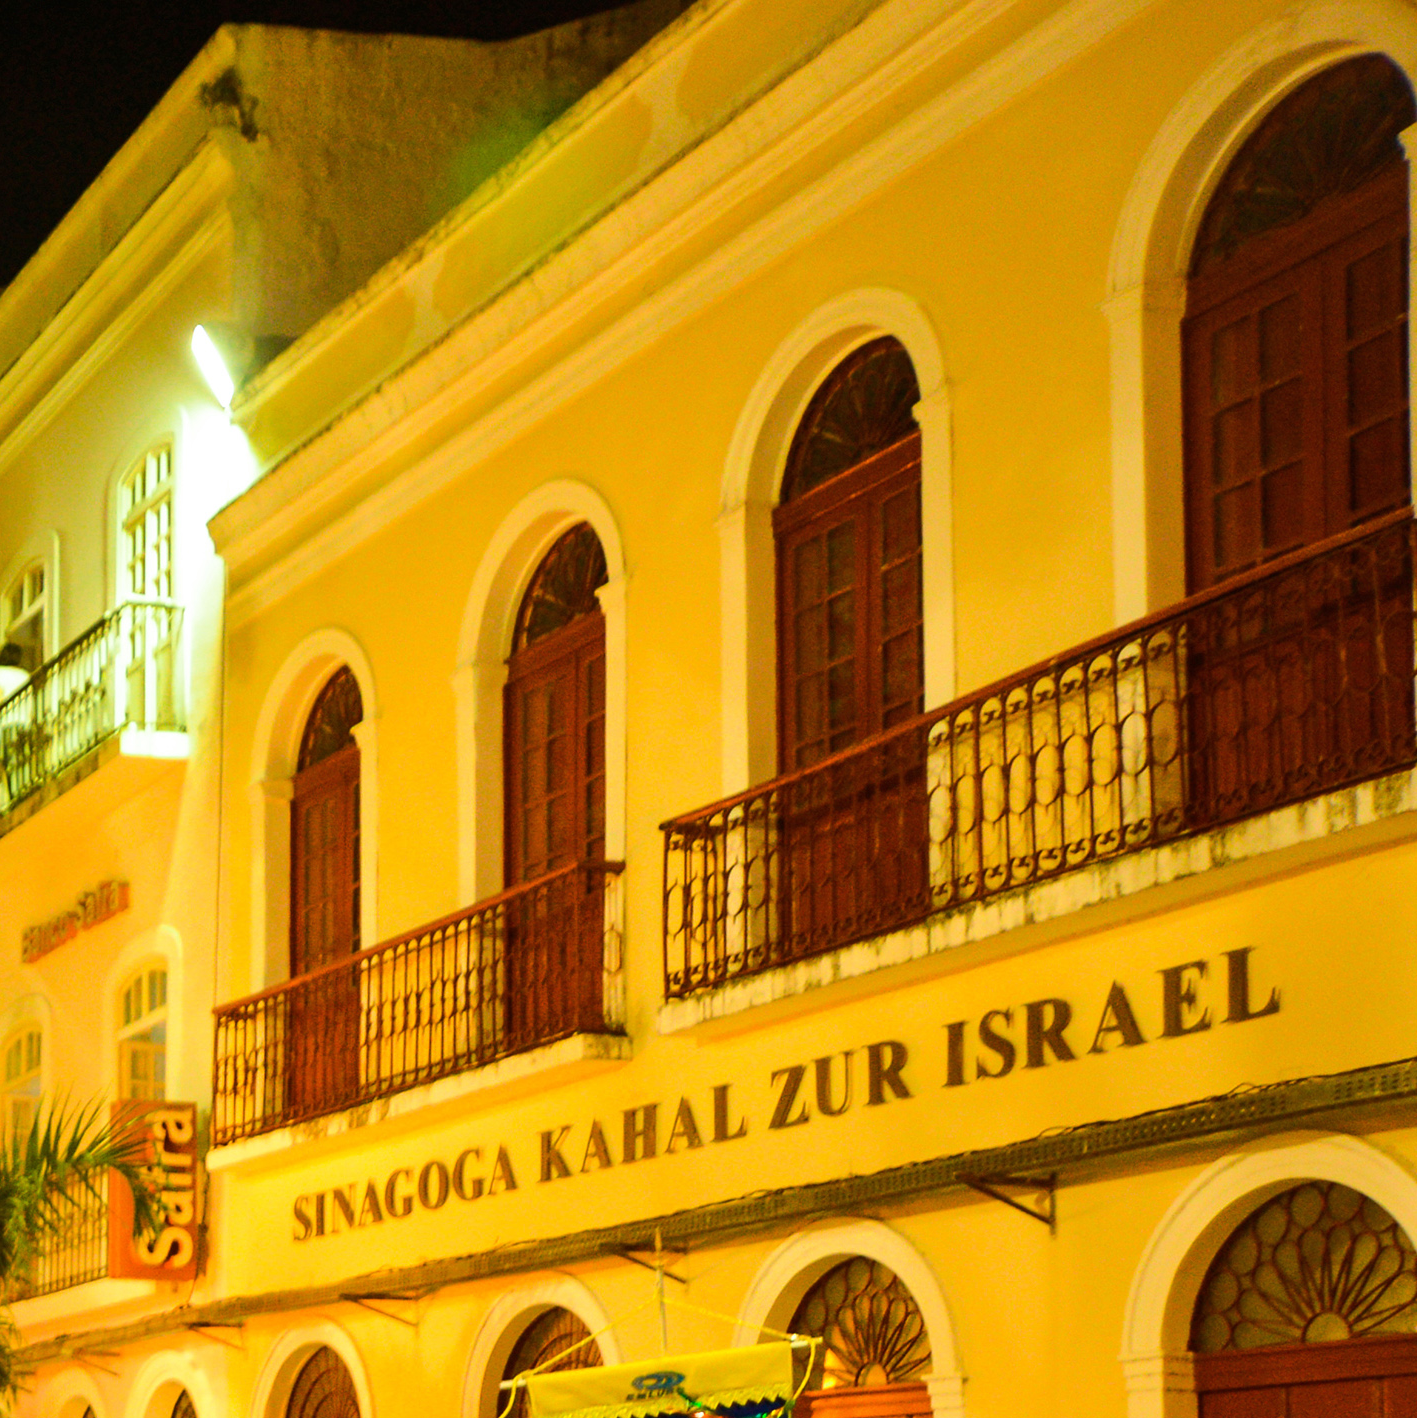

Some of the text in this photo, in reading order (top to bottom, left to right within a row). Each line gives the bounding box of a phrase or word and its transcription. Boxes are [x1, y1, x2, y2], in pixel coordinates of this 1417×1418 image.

[293, 945, 1282, 1242] SINAGOGA KAHAL ZUR ISRAEL
